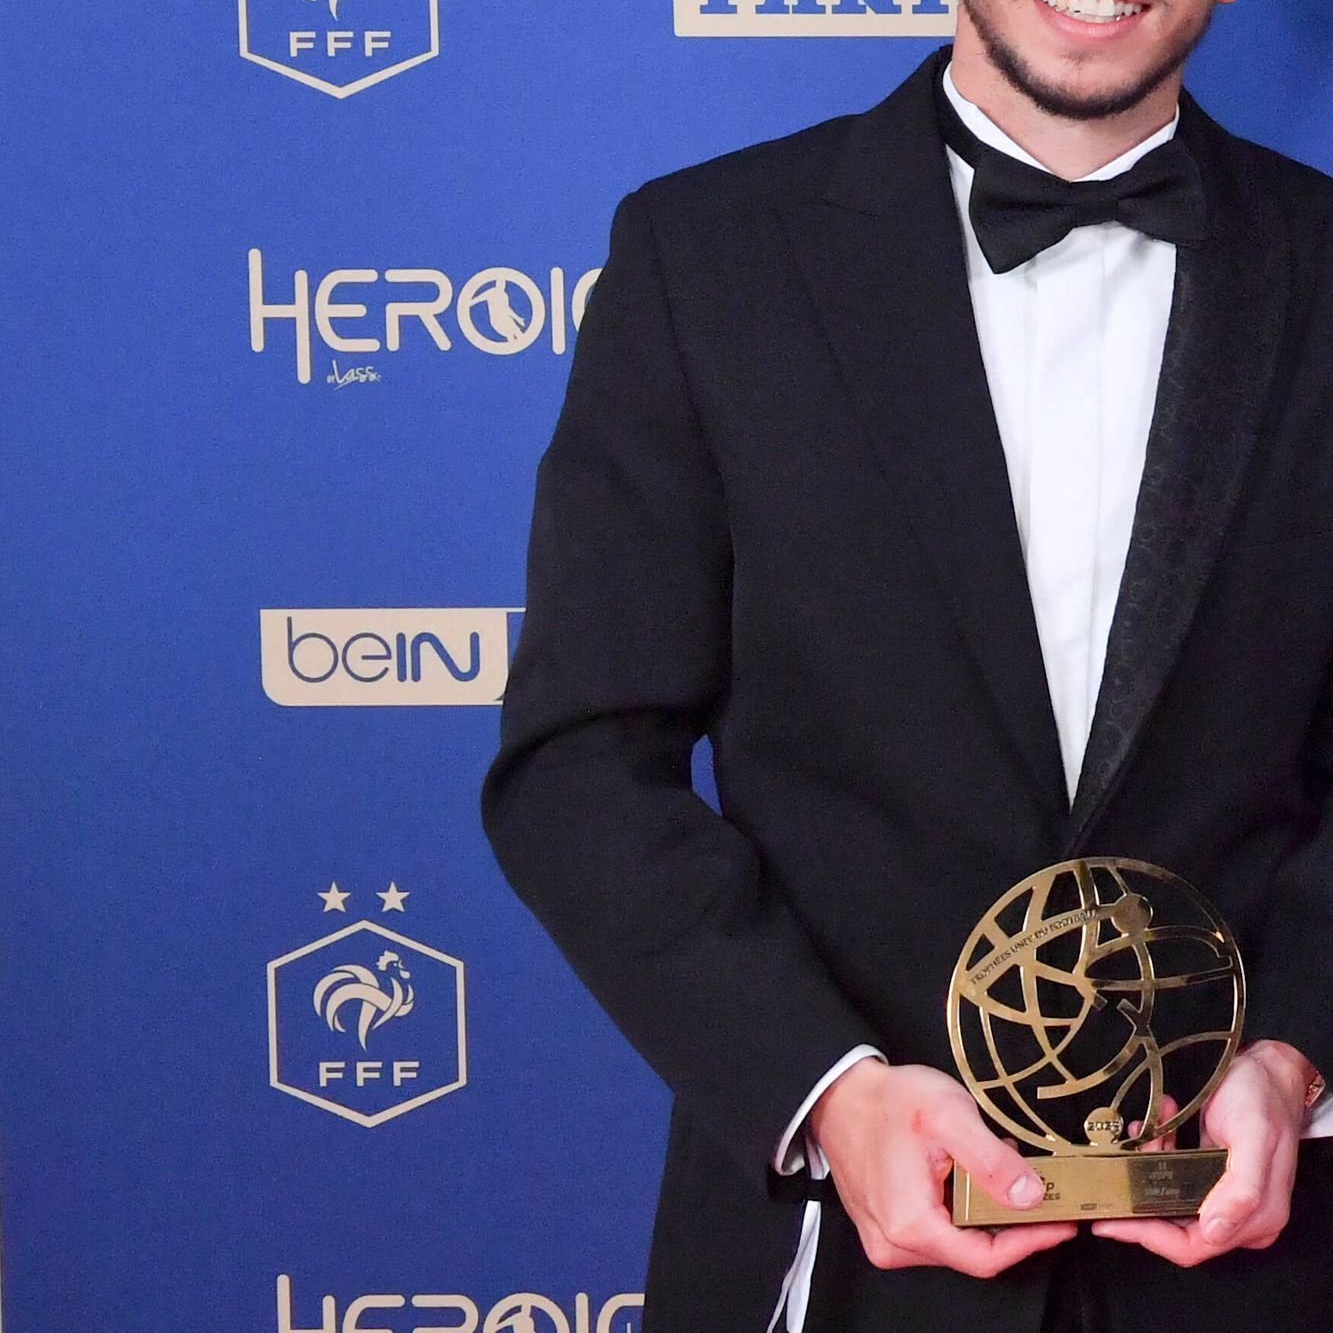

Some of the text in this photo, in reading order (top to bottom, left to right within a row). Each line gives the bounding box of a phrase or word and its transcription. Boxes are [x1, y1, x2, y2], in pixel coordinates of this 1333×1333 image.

[290, 31, 391, 57] FFF
[287, 617, 480, 683] beIN
[320, 1062, 419, 1086] FFF
